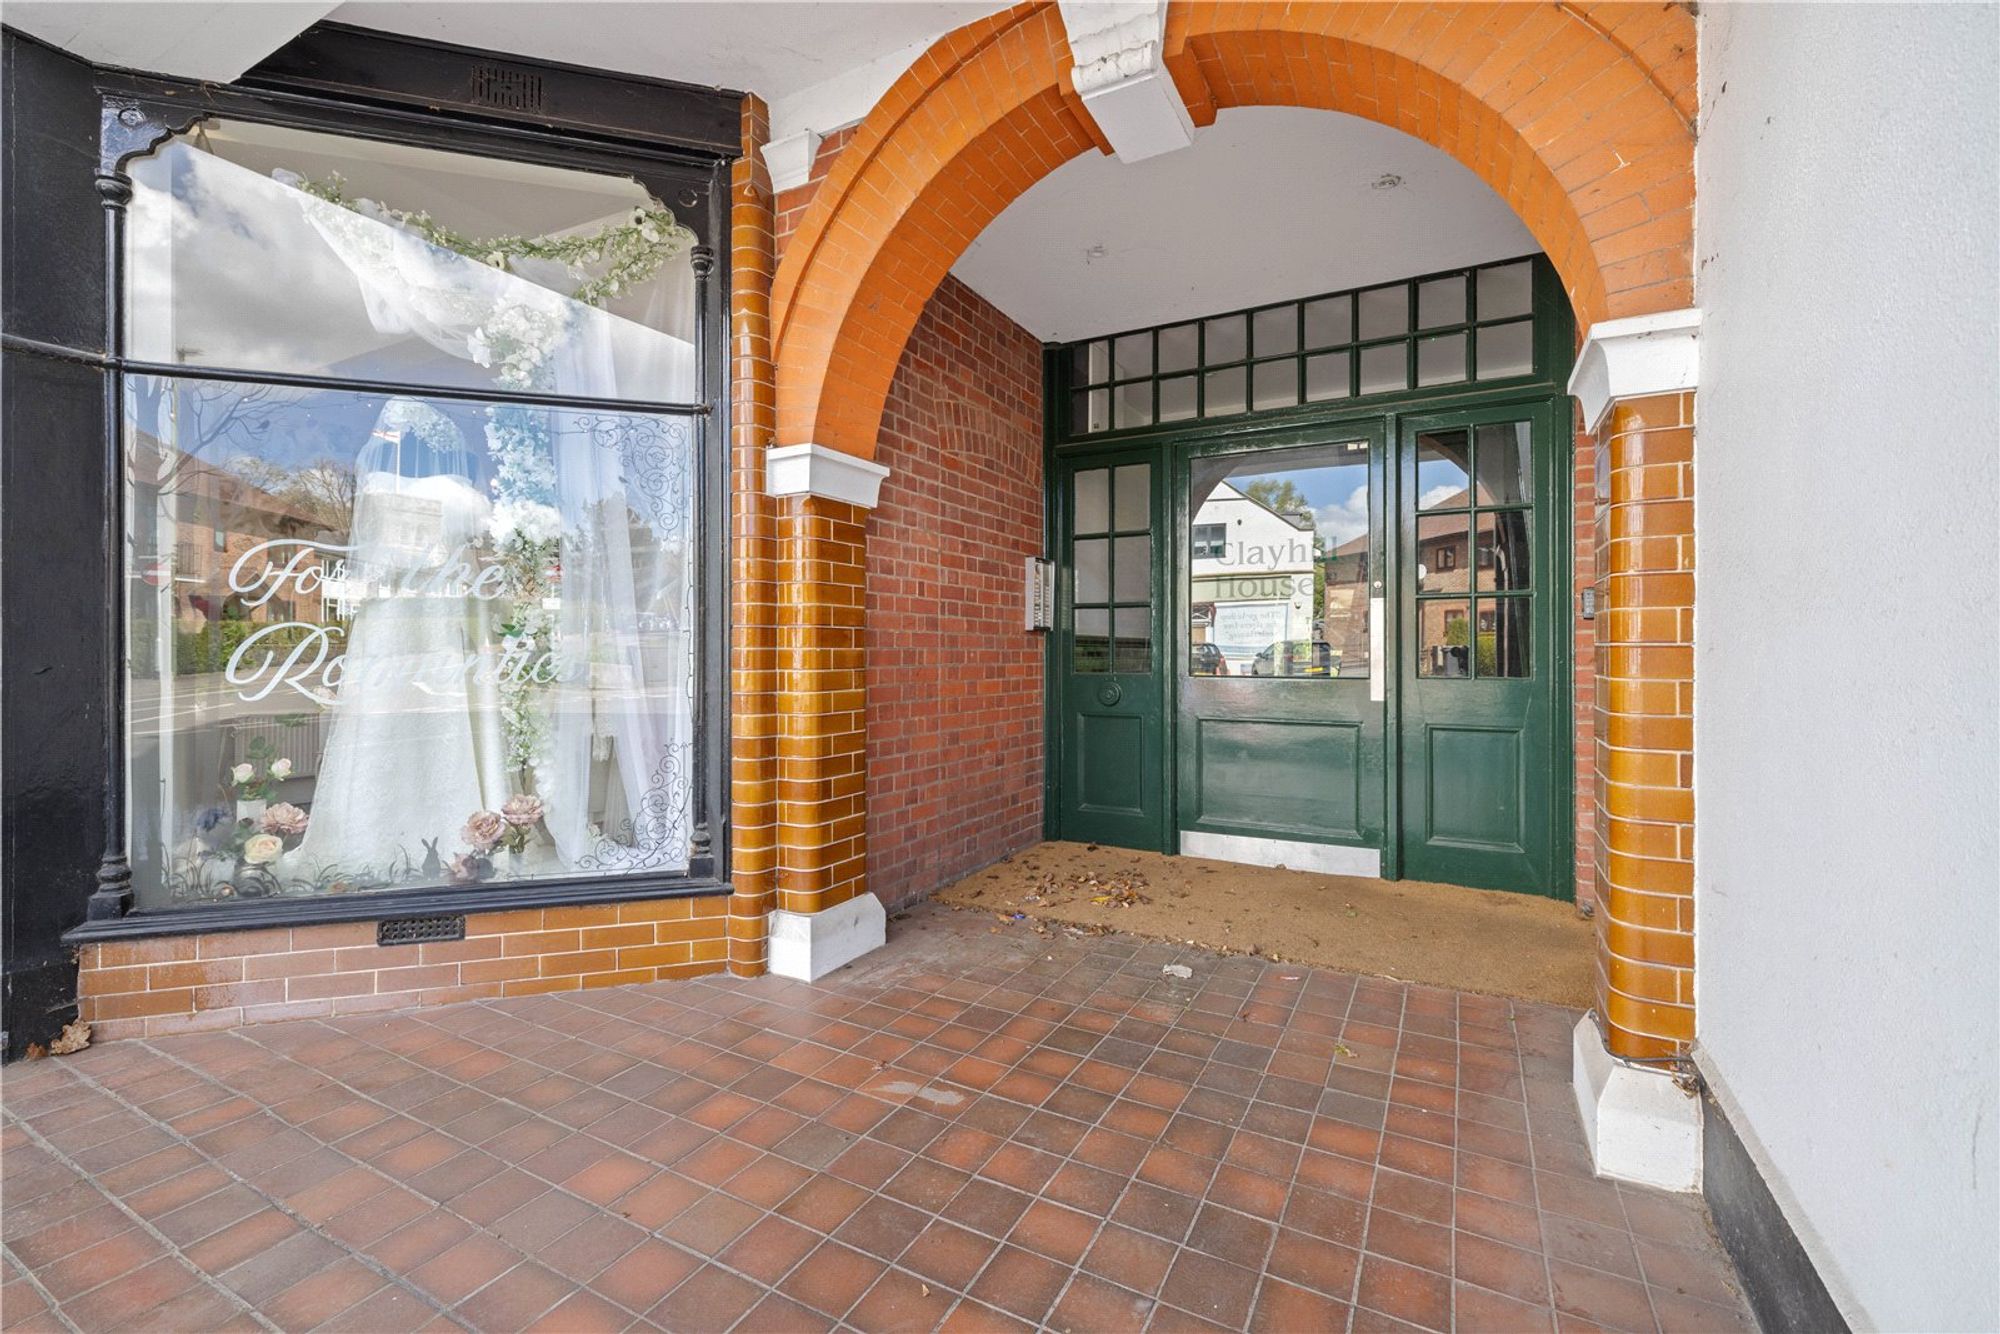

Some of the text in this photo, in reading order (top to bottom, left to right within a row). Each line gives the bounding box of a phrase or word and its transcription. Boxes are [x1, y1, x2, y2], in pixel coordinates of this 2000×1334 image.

[394, 536, 506, 600] the
[1214, 537, 1338, 570] Clayhll
[1214, 573, 1314, 598] House
[225, 621, 586, 705] Rontics
